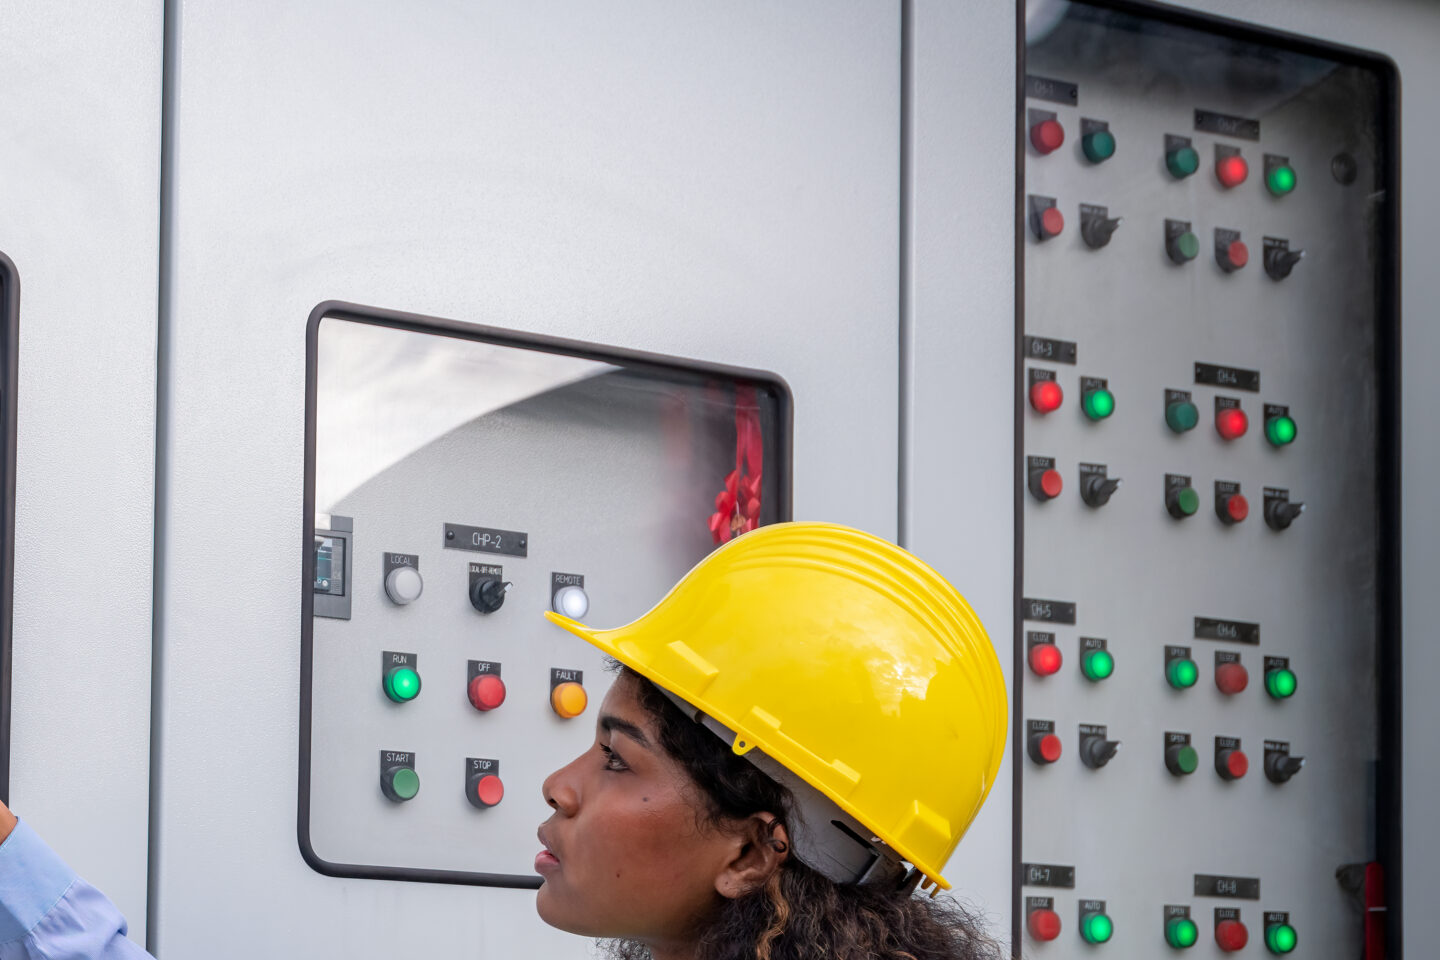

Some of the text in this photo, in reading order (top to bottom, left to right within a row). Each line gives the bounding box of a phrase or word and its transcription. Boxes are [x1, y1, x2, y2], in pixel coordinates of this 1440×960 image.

[1032, 339, 1052, 356] CH-3
[472, 532, 502, 549] CHP-2
[390, 554, 412, 565] LOCAL
[555, 574, 581, 585] REMOTE
[1031, 602, 1052, 618] CH-5
[1216, 623, 1237, 638] CH-6
[392, 654, 407, 664] RUN
[478, 663, 490, 672] OFF
[556, 670, 577, 681] FAULT
[386, 752, 409, 763] START
[473, 760, 491, 770] STOP
[1030, 867, 1050, 882] CH-7
[1216, 880, 1237, 894] CH-8
[1084, 901, 1101, 910] AUTO
